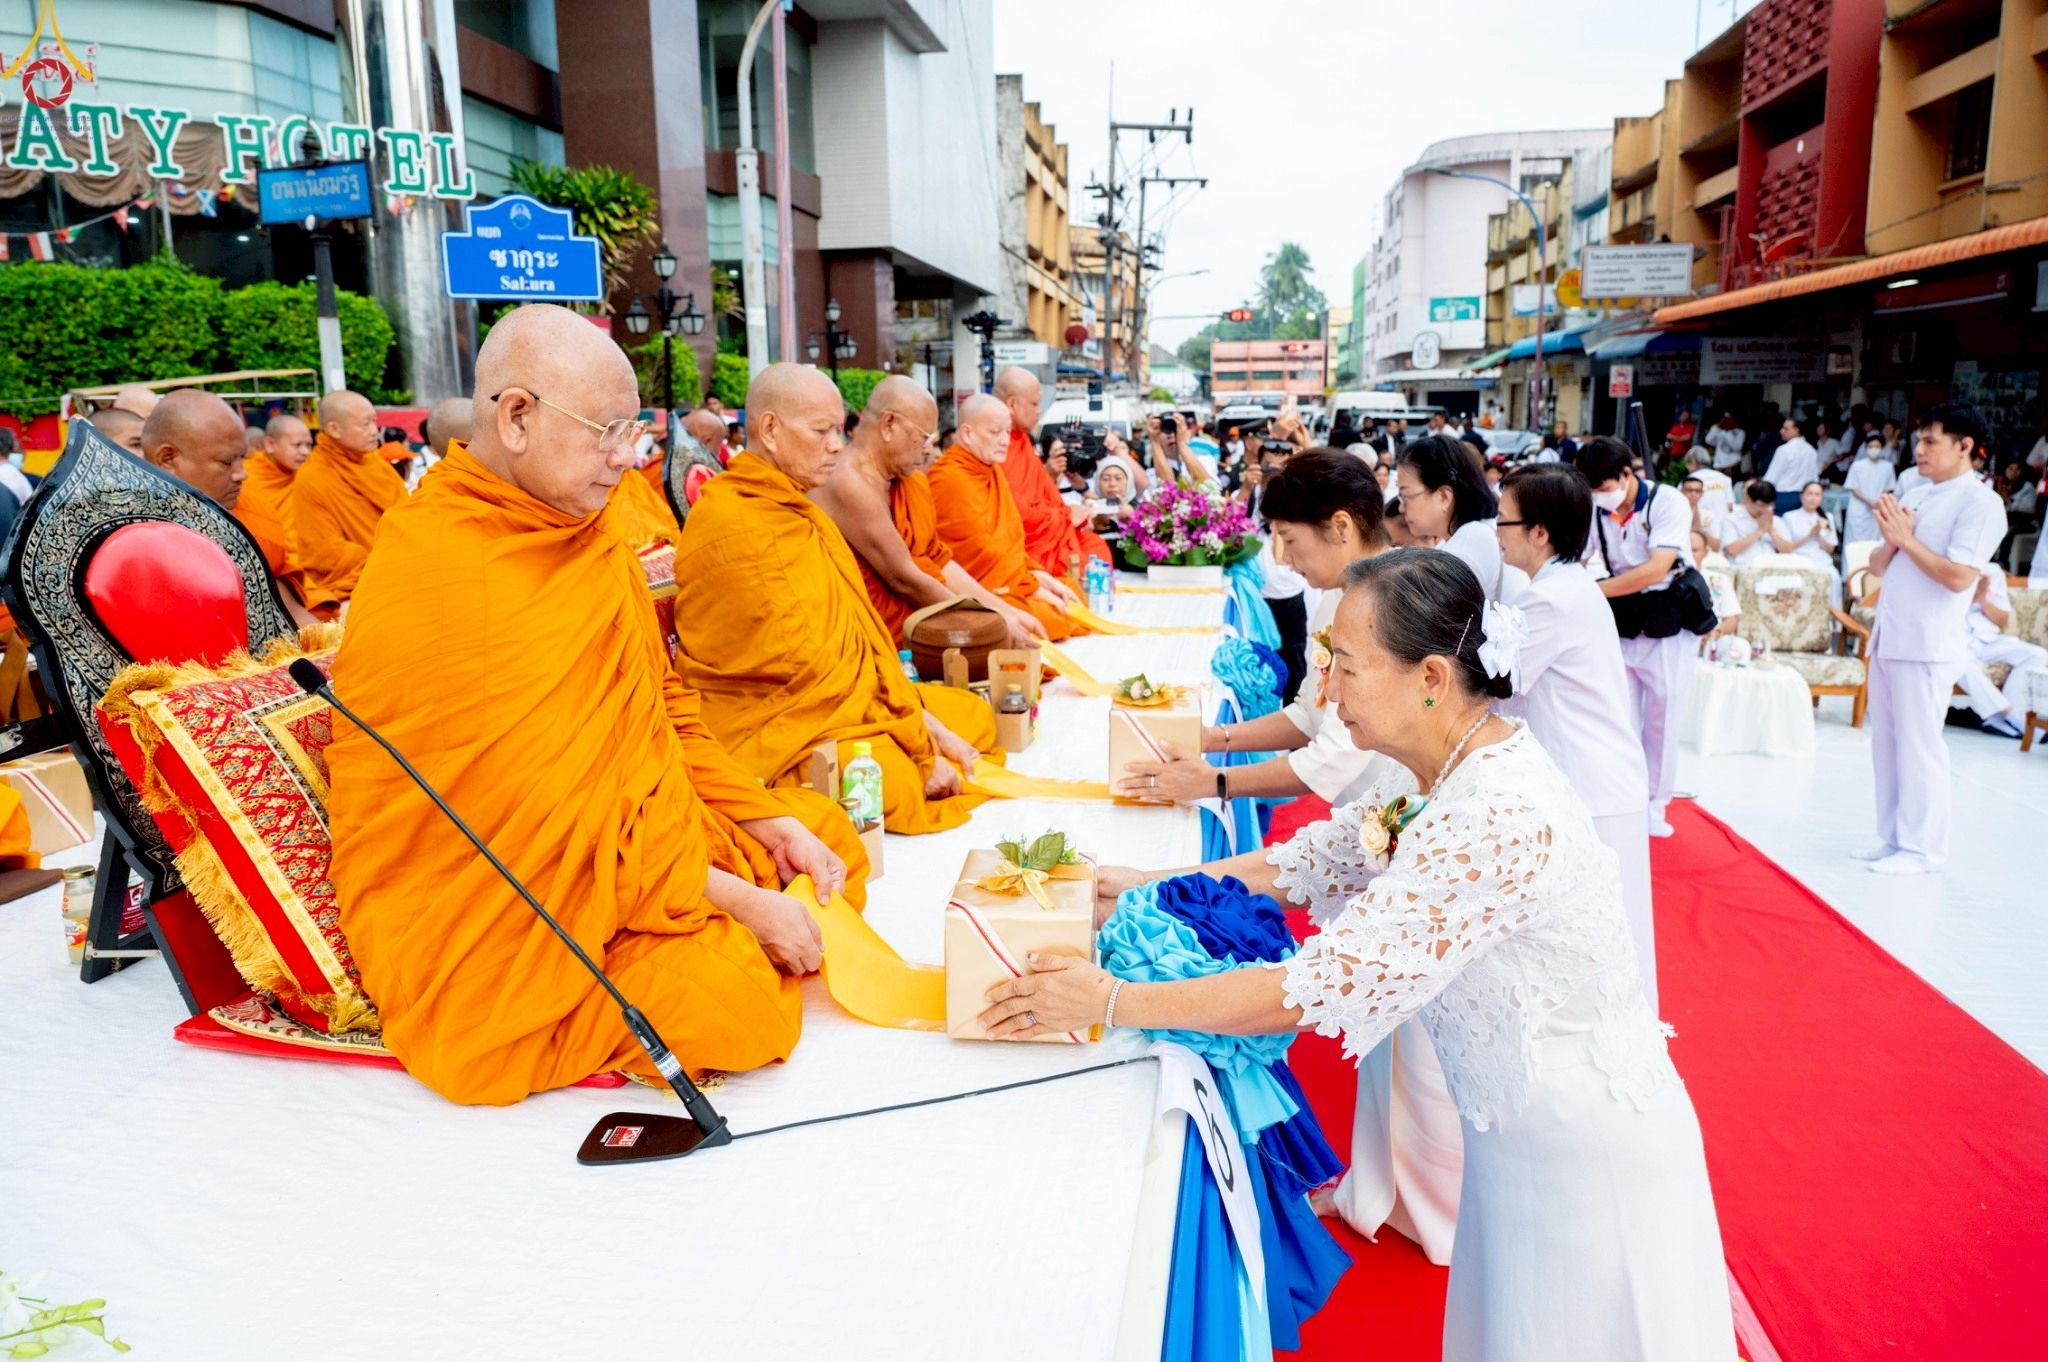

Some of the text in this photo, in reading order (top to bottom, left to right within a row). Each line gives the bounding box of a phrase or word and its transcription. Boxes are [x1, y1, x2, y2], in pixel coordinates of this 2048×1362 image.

[0, 100, 475, 199] ATY HOTEL
[489, 248, 559, 277] ซากุระ
[500, 275, 556, 292] Sakura
